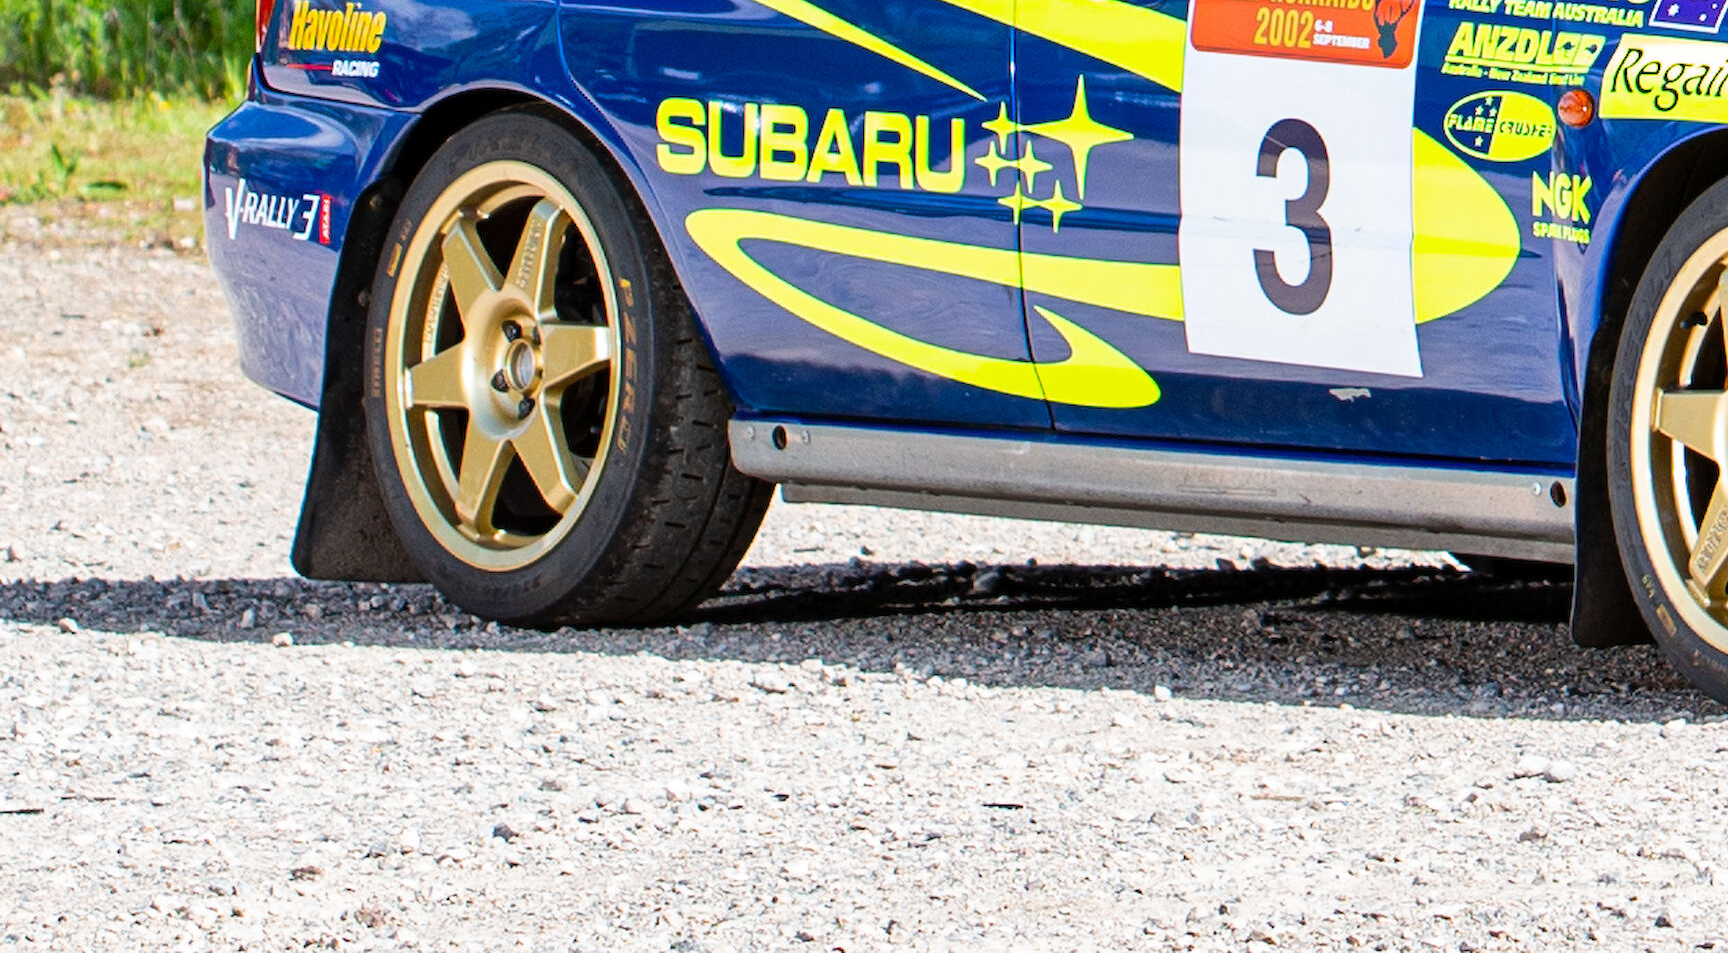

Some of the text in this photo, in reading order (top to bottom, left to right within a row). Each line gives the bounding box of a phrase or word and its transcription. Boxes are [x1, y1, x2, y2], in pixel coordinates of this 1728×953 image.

[288, 0, 388, 53] Havoline
[1254, 6, 1314, 49] 2002
[1553, 1, 1644, 28] AUSTRALIA
[1313, 33, 1371, 50] SEPTEMBER
[331, 60, 380, 78] RACING
[655, 98, 966, 193] SUBARU
[1449, 114, 1495, 134] FLAME
[225, 178, 321, 241] V-RALLY 3
[1252, 118, 1334, 316] 3
[1532, 170, 1593, 225] NGK
